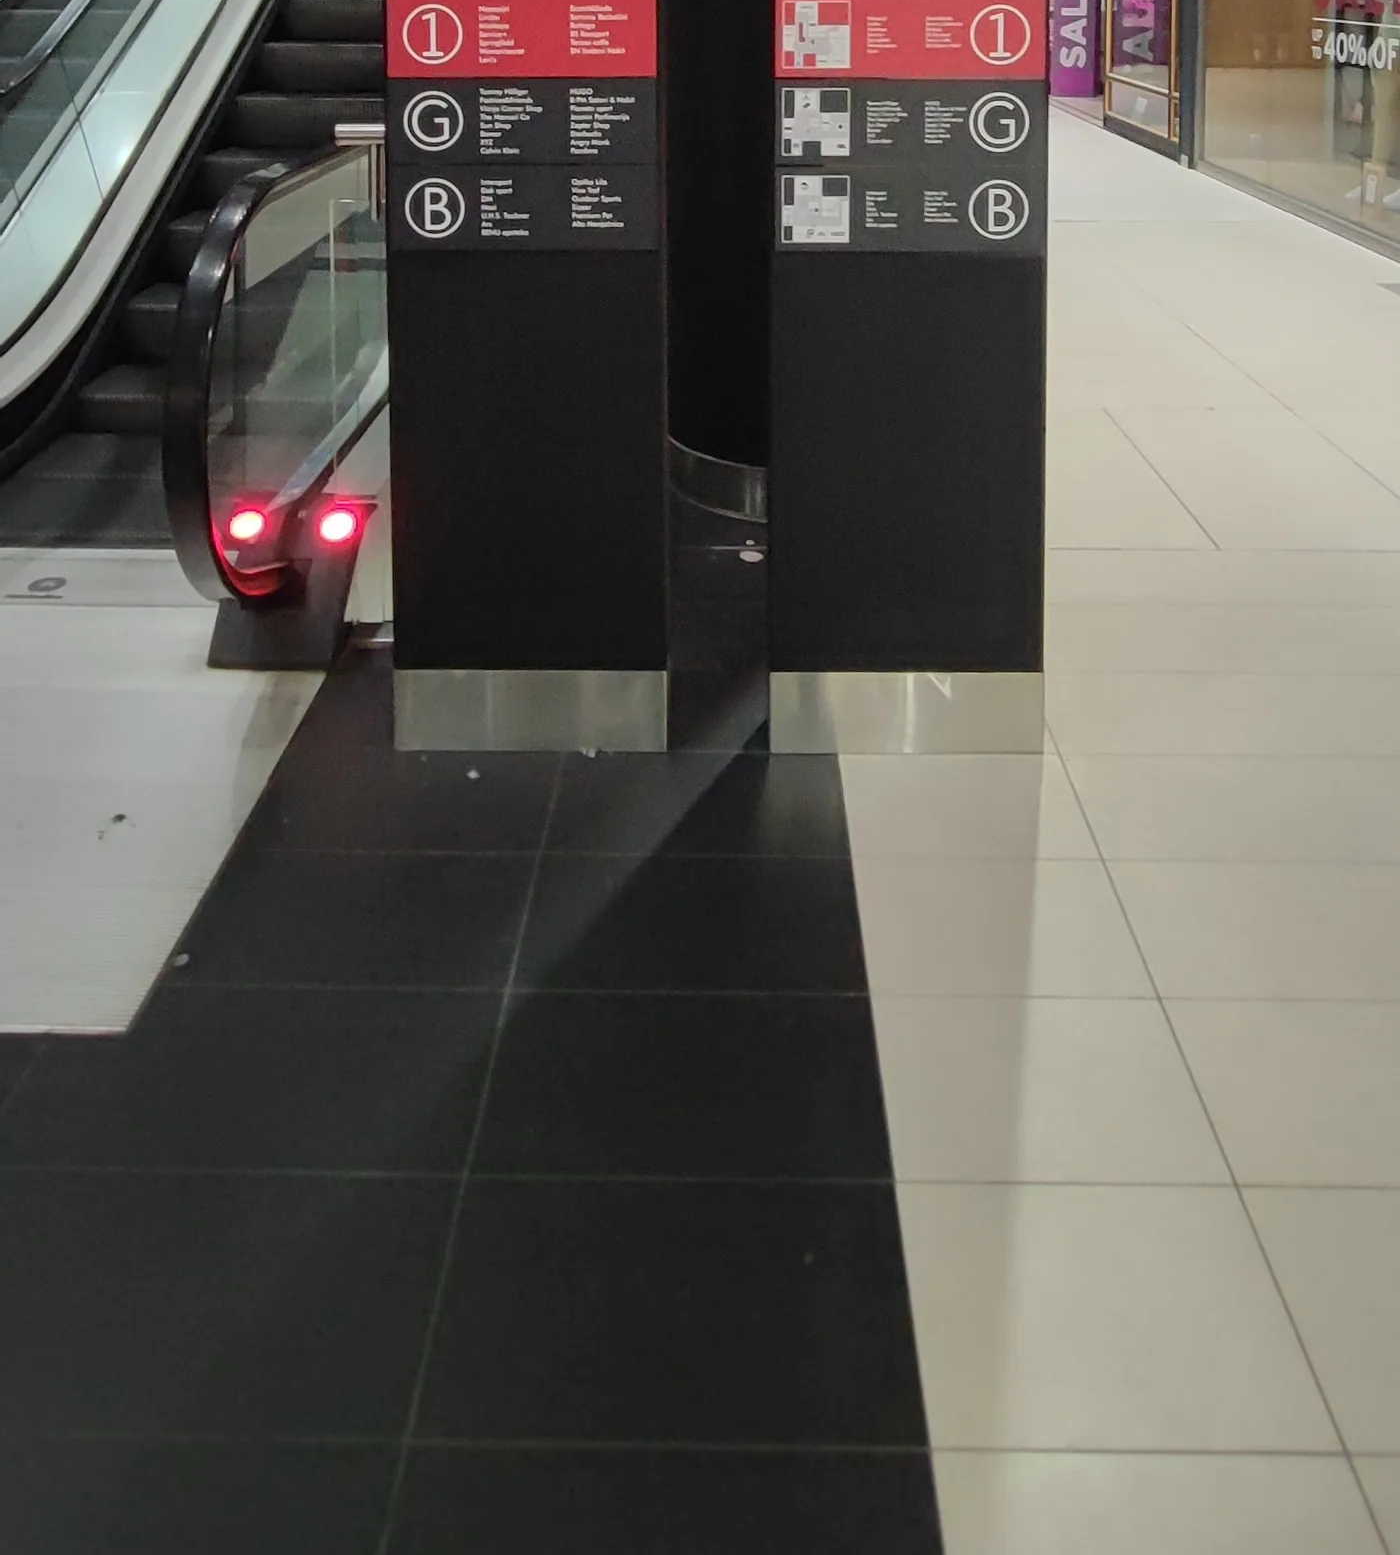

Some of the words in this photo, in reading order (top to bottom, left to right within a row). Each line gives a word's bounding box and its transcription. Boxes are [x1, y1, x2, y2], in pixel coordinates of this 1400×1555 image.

[421, 12, 444, 57] 1
[989, 12, 1012, 57] 1
[1311, 28, 1324, 42] UP
[1311, 45, 1323, 60] TO
[1324, 31, 1367, 67] 40%
[412, 99, 450, 143] G
[977, 100, 1016, 145] G
[424, 187, 452, 231] B
[988, 189, 1015, 232] B
